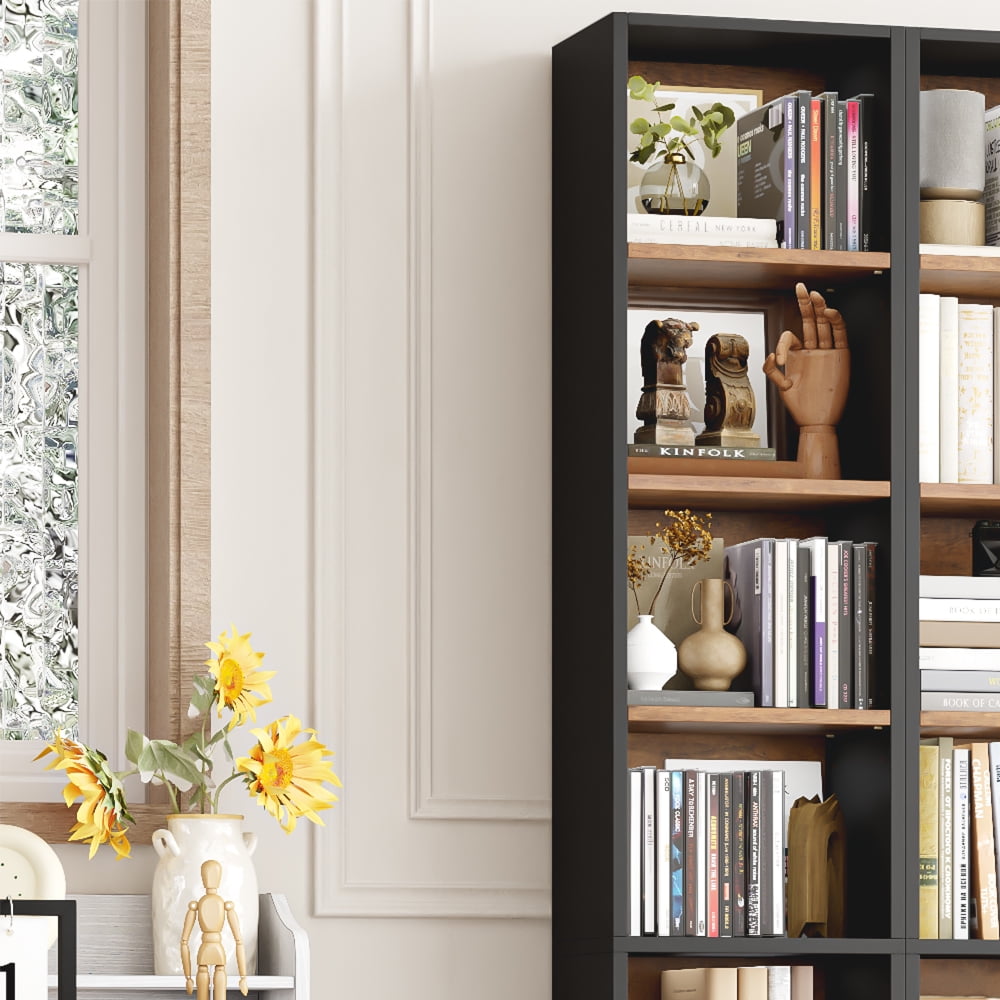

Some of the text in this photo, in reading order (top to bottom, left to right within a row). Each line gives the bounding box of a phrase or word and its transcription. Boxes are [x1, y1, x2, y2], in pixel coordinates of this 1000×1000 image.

[660, 447, 745, 458] KINFOLK
[943, 698, 969, 708] BOOK
[972, 699, 985, 708] OF
[971, 758, 985, 819] CHAPMAN
